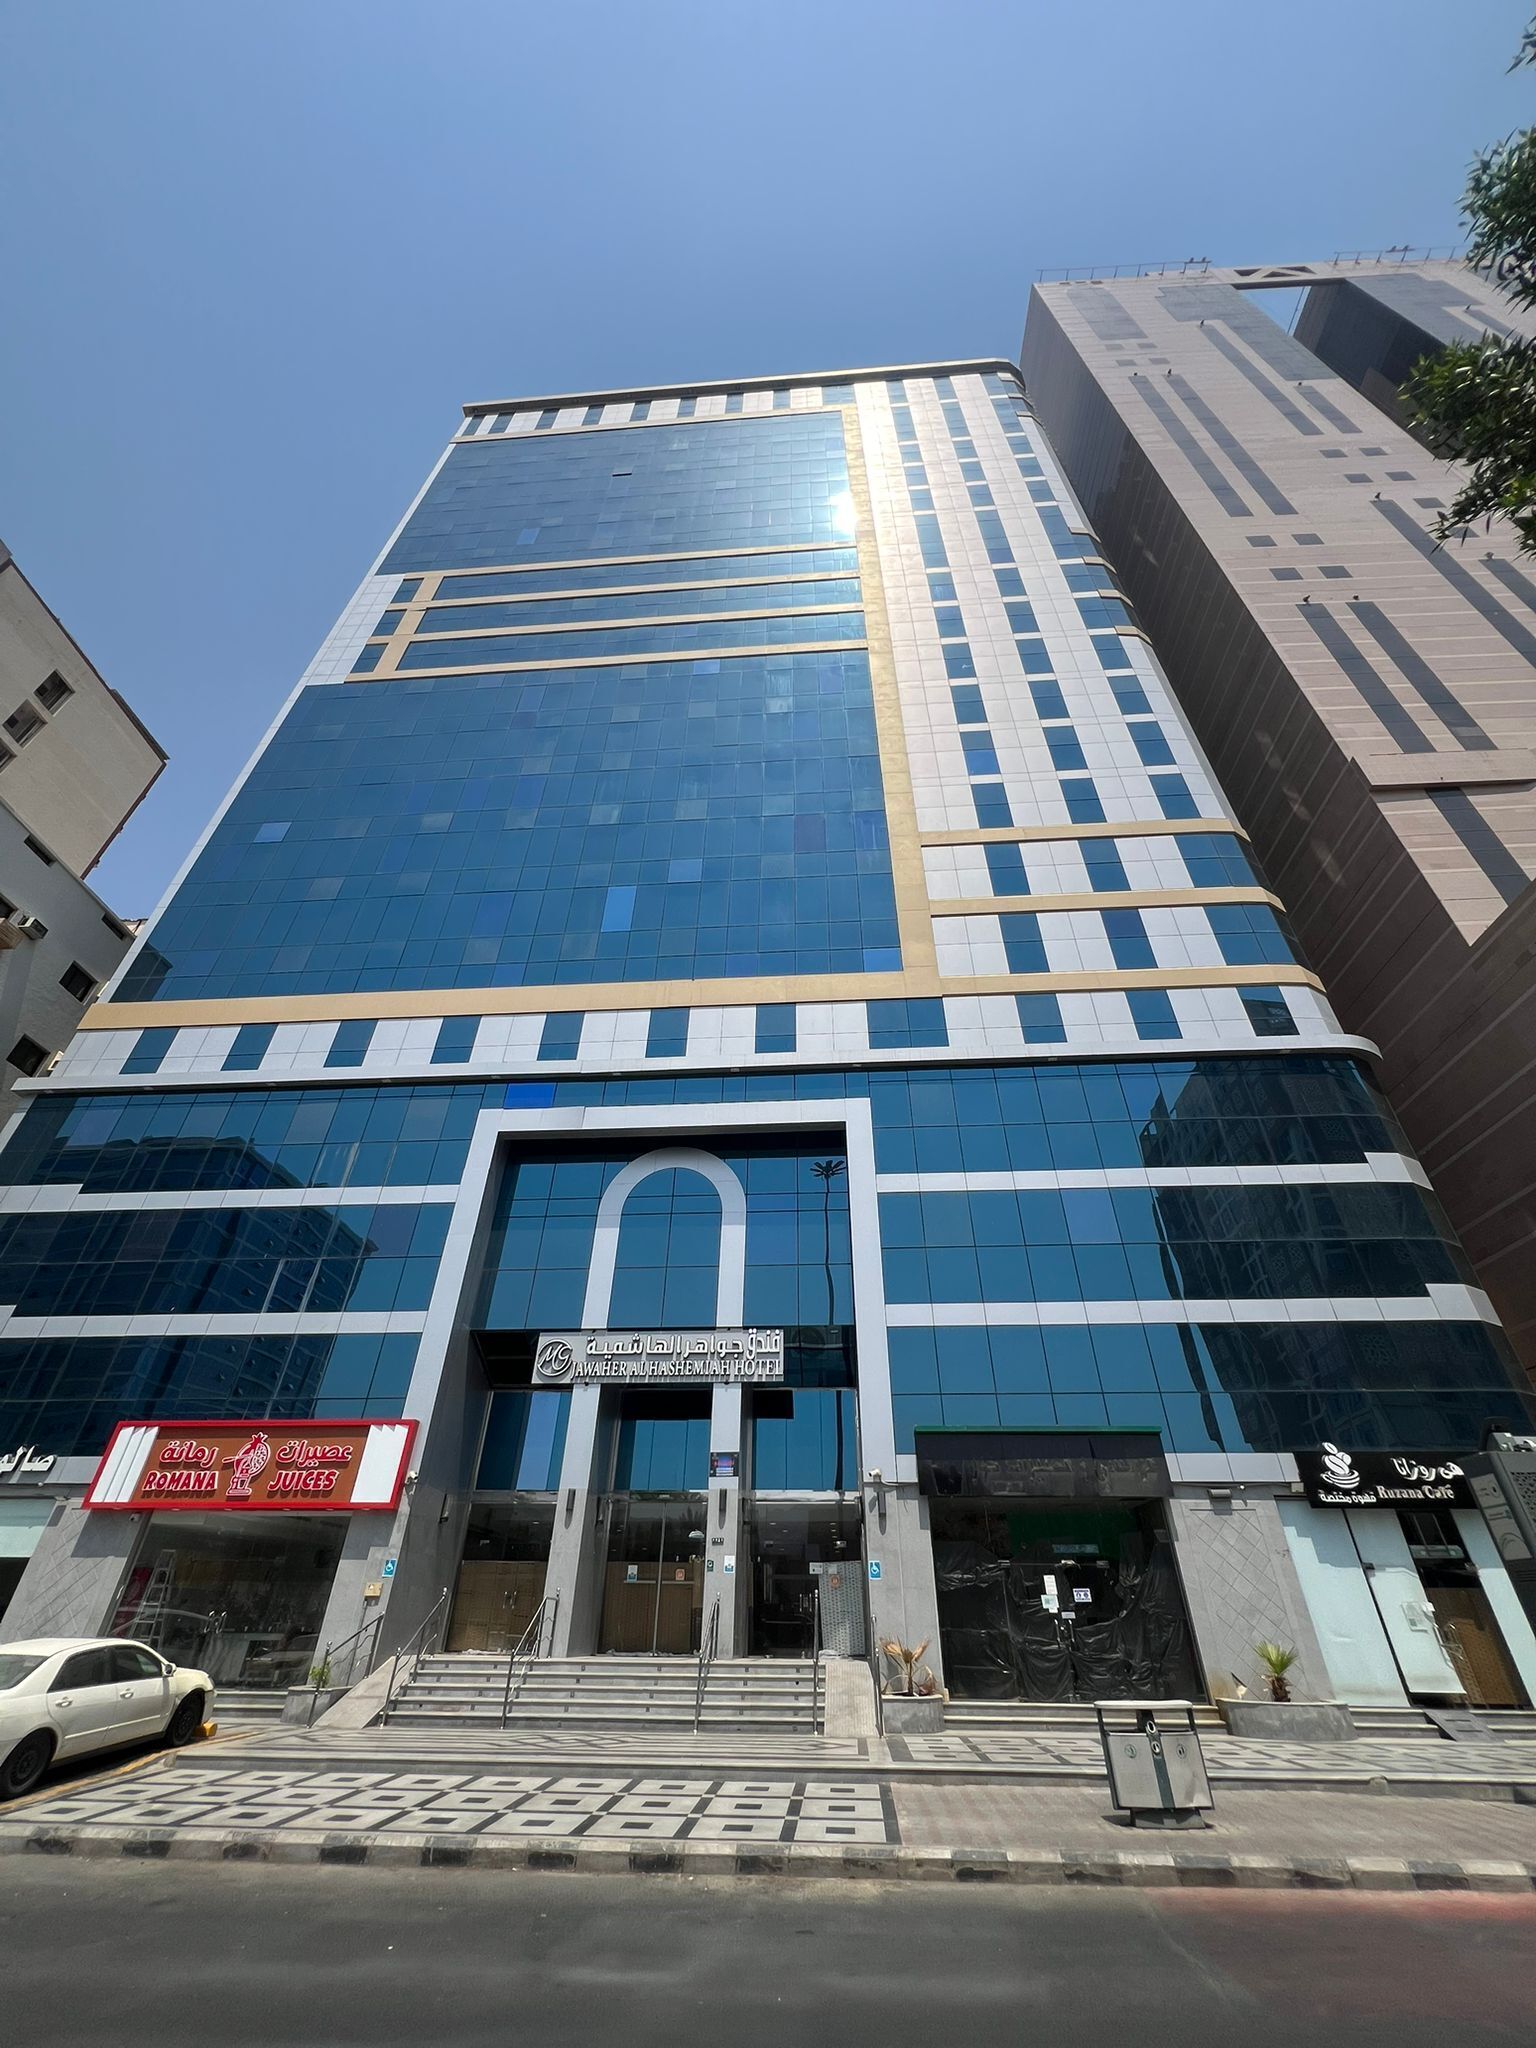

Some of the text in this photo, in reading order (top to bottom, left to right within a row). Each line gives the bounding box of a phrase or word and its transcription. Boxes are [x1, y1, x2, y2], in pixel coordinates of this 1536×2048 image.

[586, 1328, 780, 1359] فندق جواهر الهاشمية
[570, 1360, 783, 1380] JAWAHER AL HASHEMIAH HOTEL
[159, 1441, 219, 1469] رمانة
[275, 1440, 352, 1467] عصيرات
[142, 1470, 219, 1491] ROMANA
[267, 1469, 340, 1491] JUICES
[1390, 1457, 1436, 1481] روزانا
[1375, 1485, 1424, 1499] Ruzana
